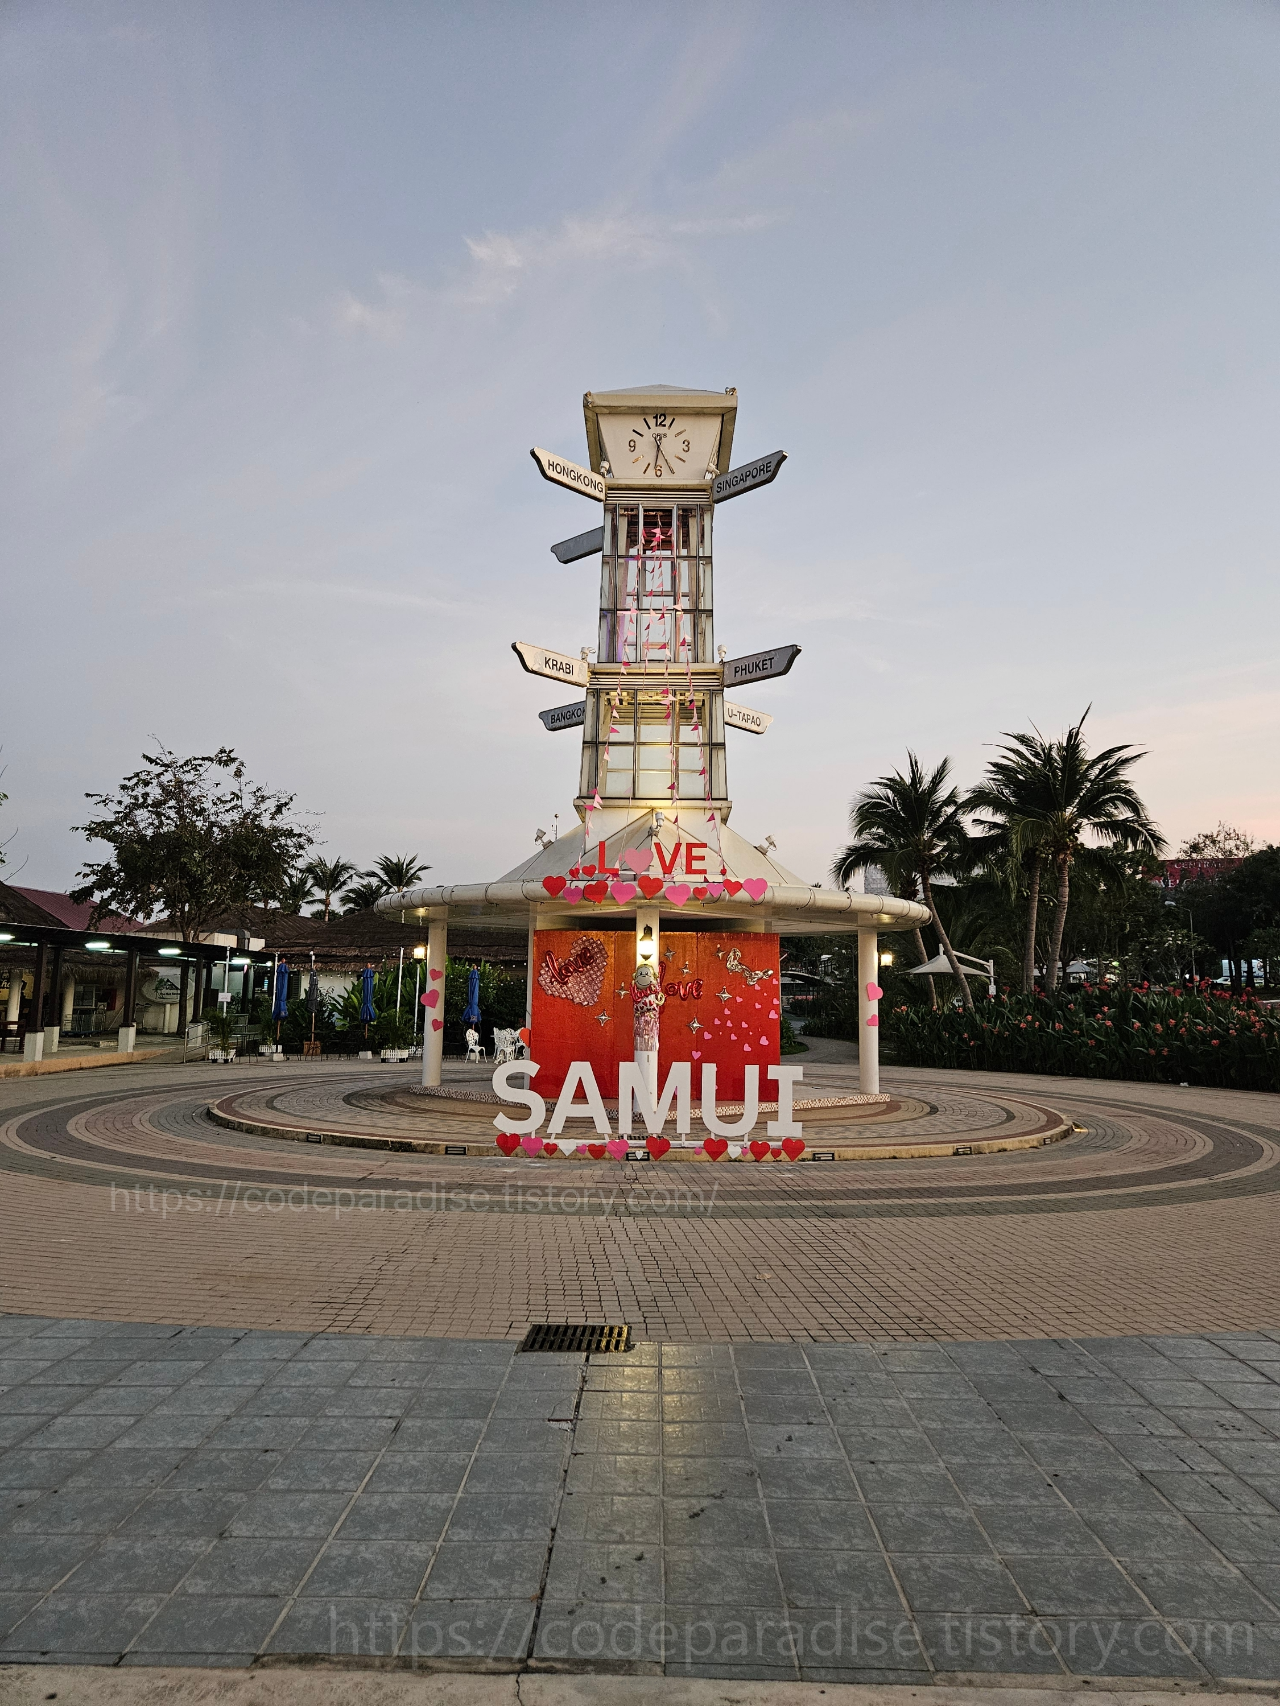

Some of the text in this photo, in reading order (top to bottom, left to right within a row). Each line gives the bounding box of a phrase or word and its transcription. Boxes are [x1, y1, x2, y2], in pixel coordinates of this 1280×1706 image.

[653, 413, 667, 427] 12
[628, 439, 636, 452] 9
[682, 439, 690, 452] 3
[547, 459, 604, 493] HONGKONG
[654, 464, 662, 477] 6
[715, 461, 772, 494] SINGAPORE
[544, 656, 574, 676] KRABI
[733, 657, 775, 678] PHUKET
[727, 707, 762, 727] U-TAPAO
[491, 1060, 804, 1138] SAMUI
